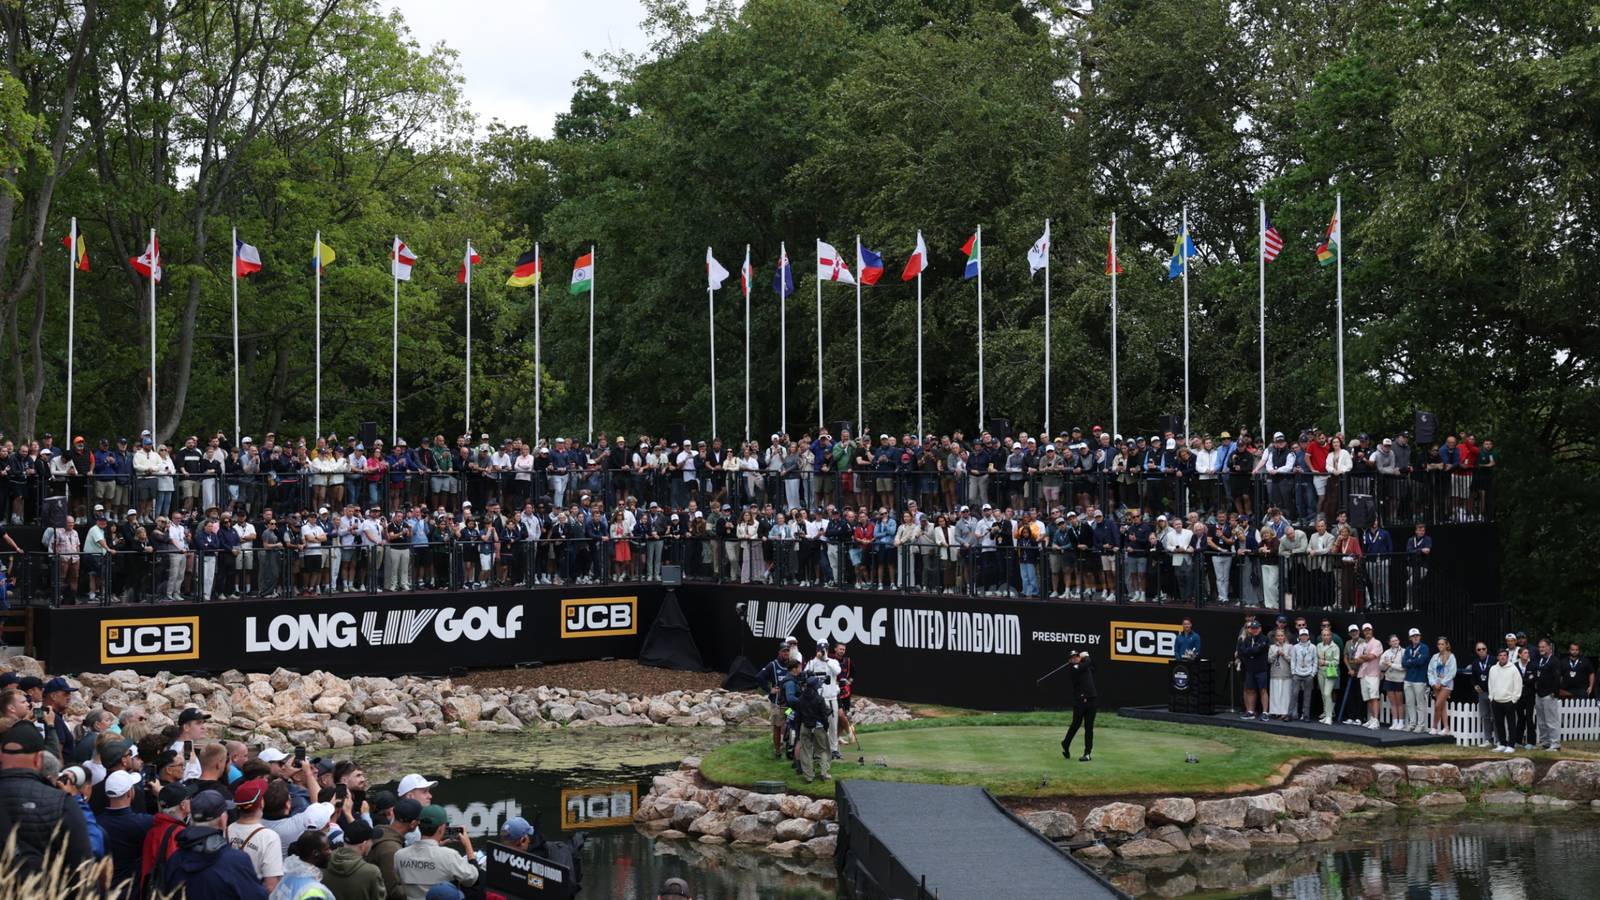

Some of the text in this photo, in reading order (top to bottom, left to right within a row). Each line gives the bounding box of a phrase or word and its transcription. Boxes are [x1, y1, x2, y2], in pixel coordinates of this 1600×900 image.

[245, 604, 524, 652] LONG LIV GOLF
[567, 604, 631, 630] JCB
[746, 600, 1021, 656] LIV GOLF UNITED KINGDOM
[108, 625, 191, 655] JCB
[1032, 631, 1101, 645] PRESENTED BY
[1116, 629, 1176, 656] JCB
[399, 859, 436, 871] MANORS
